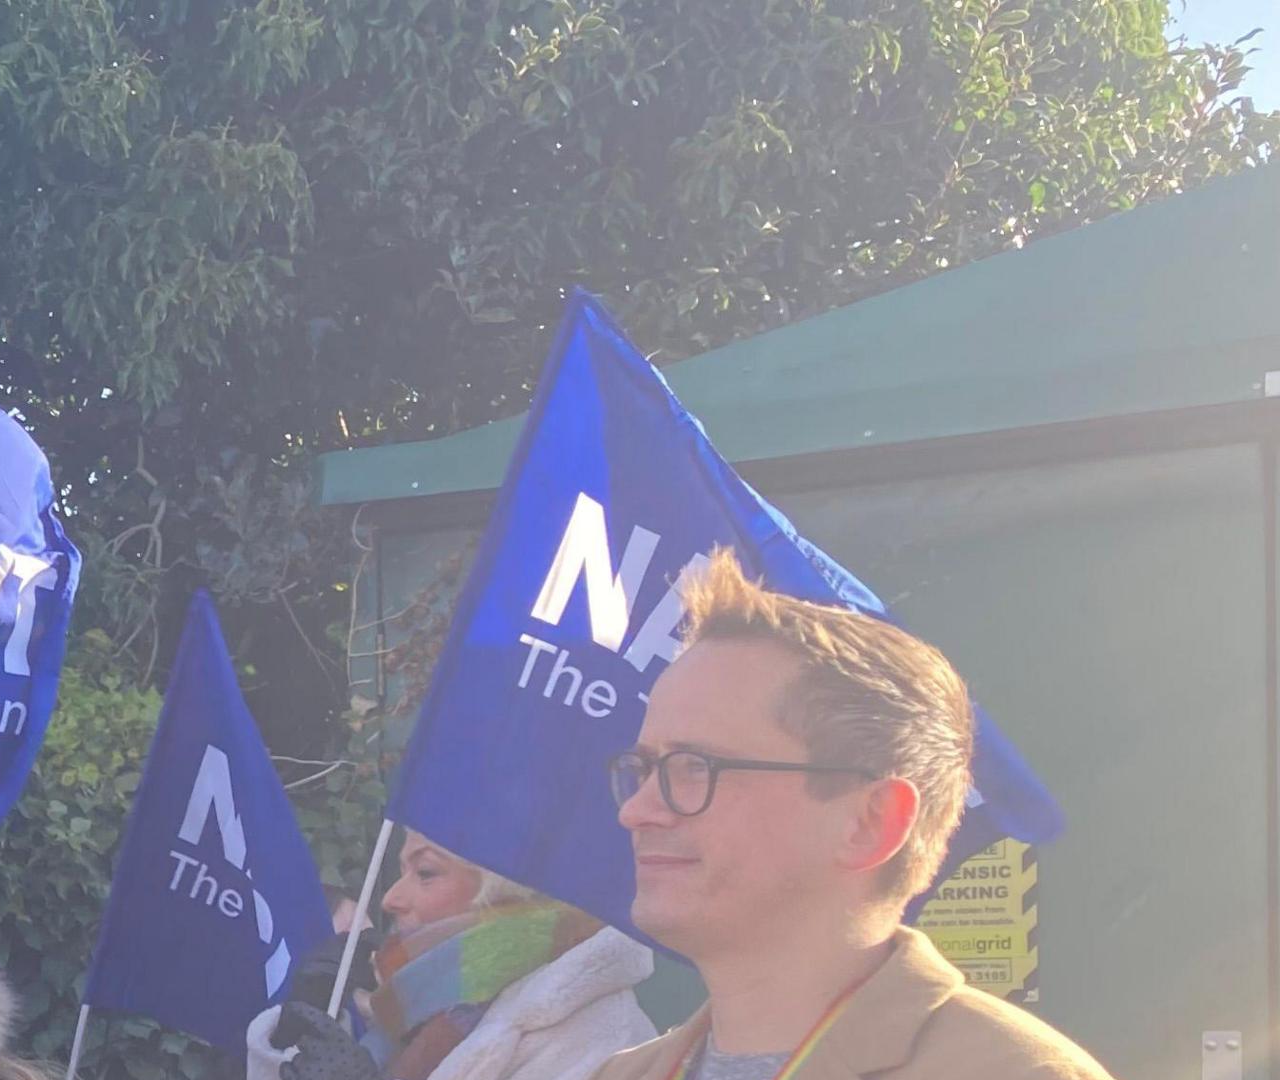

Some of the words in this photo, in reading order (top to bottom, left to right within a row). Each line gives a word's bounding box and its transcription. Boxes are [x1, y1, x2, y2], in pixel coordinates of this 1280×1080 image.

[518, 633, 618, 718] The
[951, 865, 1012, 880] NSIC
[170, 850, 244, 919] The
[937, 886, 1009, 900] RKING
[940, 935, 1012, 953] onalgrid
